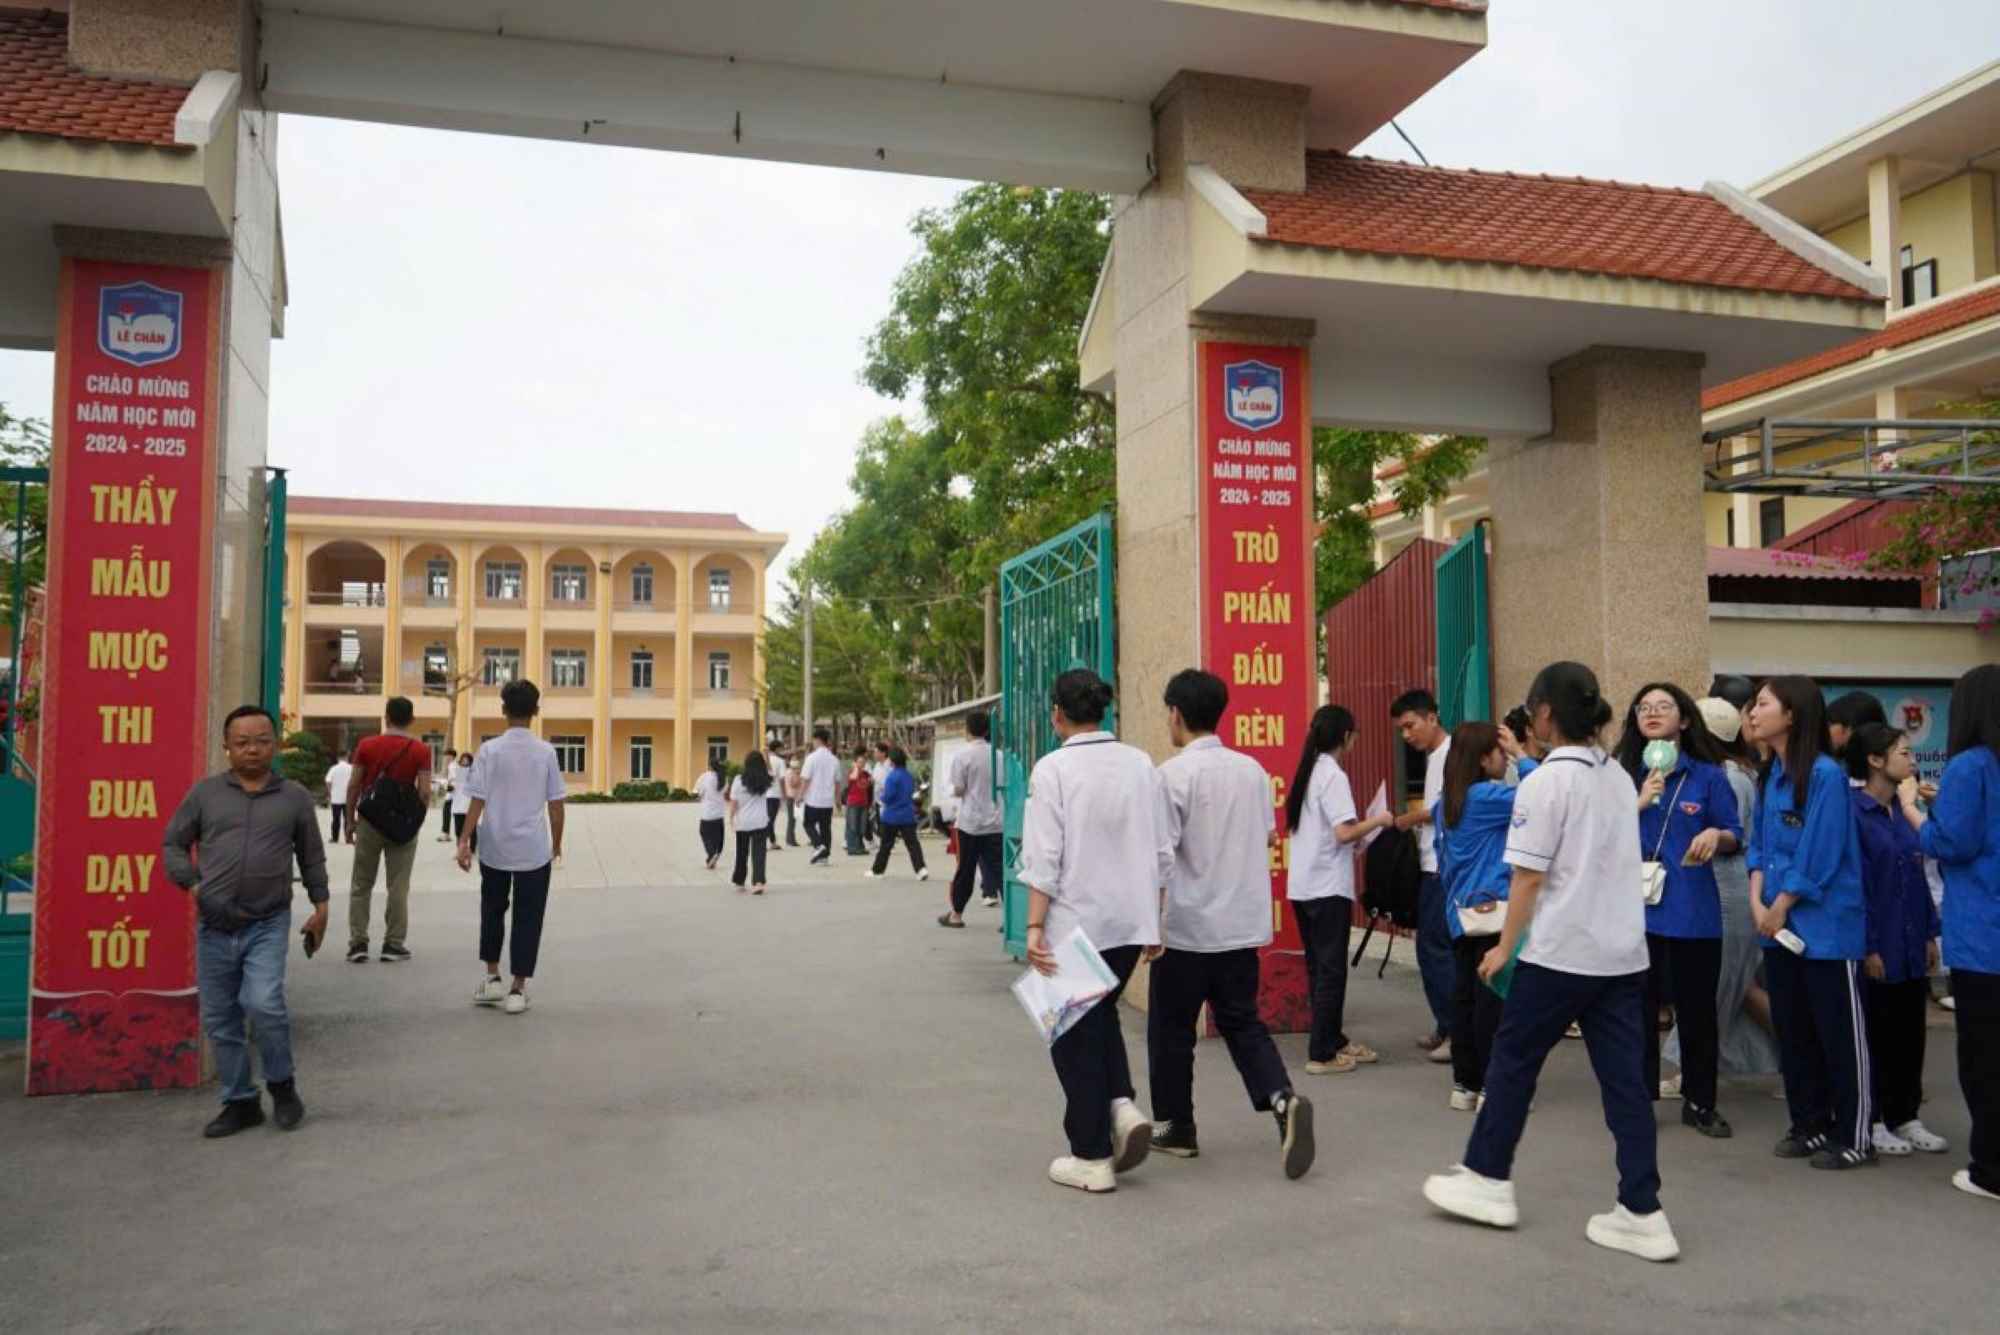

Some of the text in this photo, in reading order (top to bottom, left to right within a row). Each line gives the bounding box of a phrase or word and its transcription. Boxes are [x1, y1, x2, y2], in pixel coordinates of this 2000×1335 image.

[87, 373, 189, 398] CHÀO MỪNG
[77, 401, 196, 430] NĂM HỌC MỚI
[85, 433, 128, 454] 2024
[144, 436, 186, 457] 2025
[1218, 437, 1291, 457] CHÀO MỪNG
[1213, 460, 1297, 484] NĂM HỌC MỚI
[90, 474, 178, 525] THẦY
[1220, 487, 1250, 505] 2024
[1261, 489, 1291, 507] 2025
[1232, 524, 1279, 563] TRÒ
[91, 544, 171, 598] MẪU
[1224, 581, 1291, 624] PHẤN
[88, 628, 168, 678] MỰC
[1233, 641, 1283, 685] ĐẤU
[98, 705, 154, 744] THI
[1235, 707, 1284, 747] RÈN
[88, 779, 158, 819] ĐUA
[85, 854, 157, 901] DẠY
[88, 915, 151, 968] TỐT
